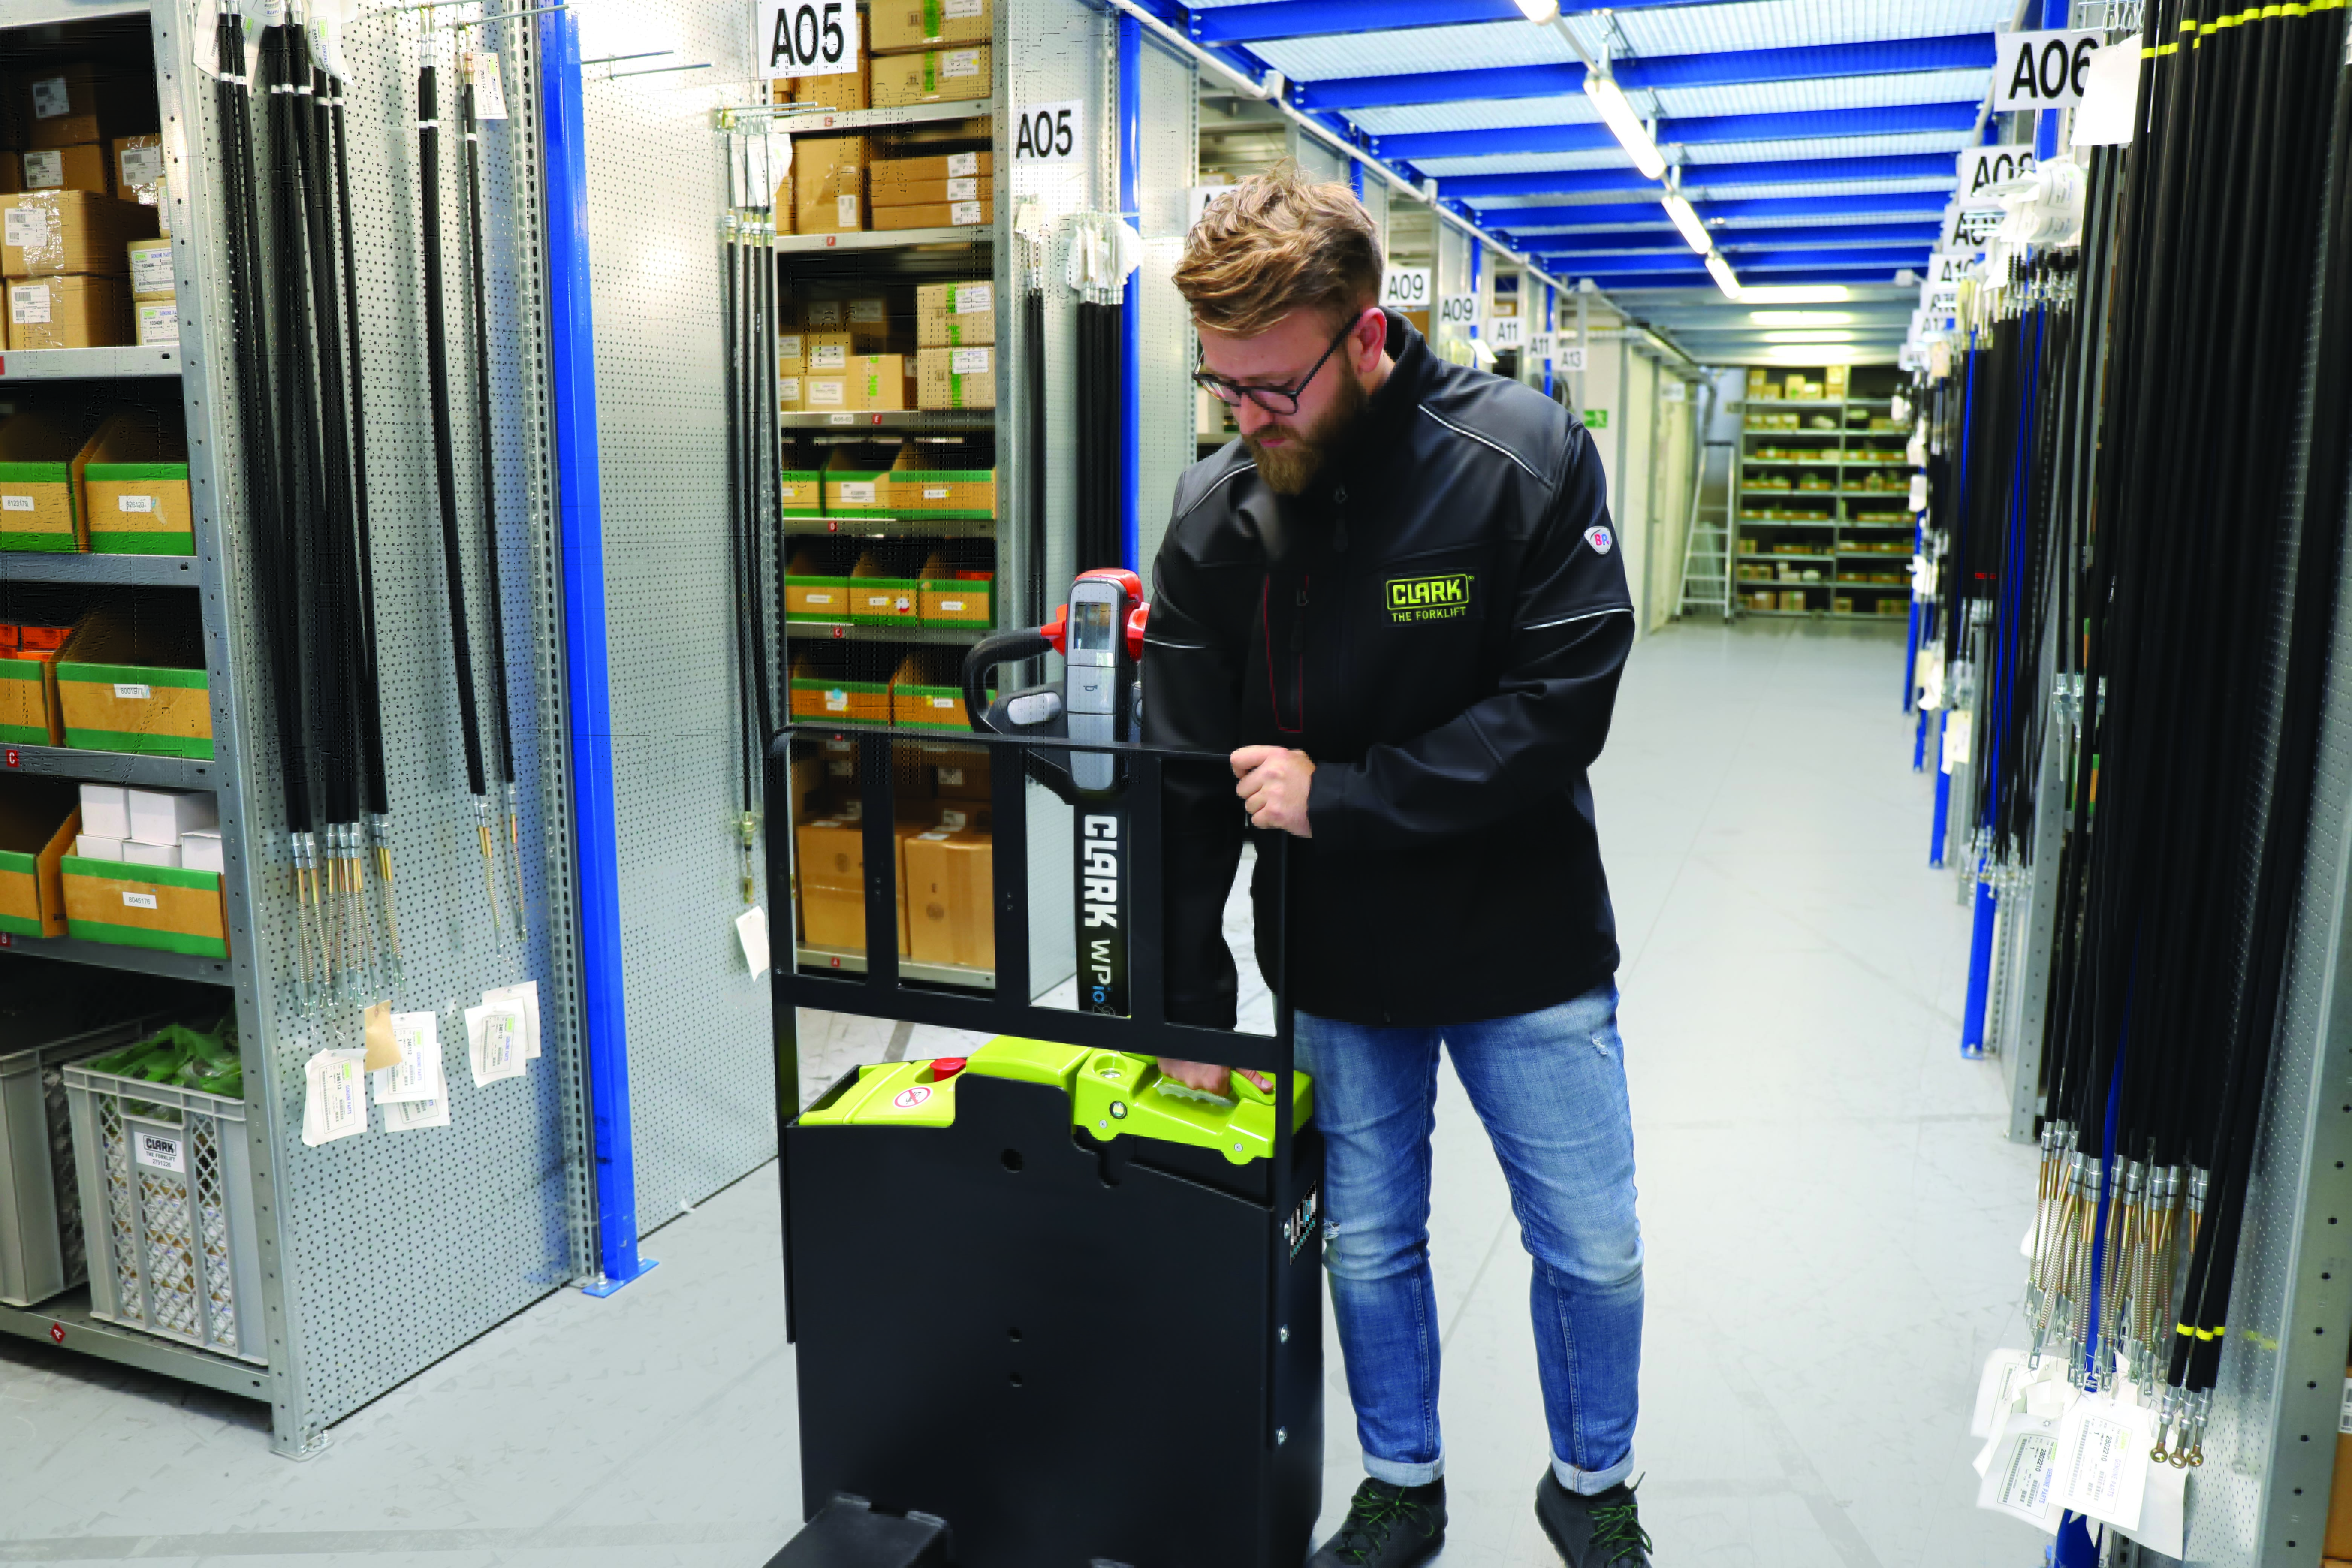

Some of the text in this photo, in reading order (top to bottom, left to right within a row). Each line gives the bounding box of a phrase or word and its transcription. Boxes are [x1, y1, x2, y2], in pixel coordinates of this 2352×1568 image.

[770, 3, 844, 67] A05
[2009, 38, 2099, 99] A06
[1016, 110, 1073, 159] A05
[1387, 274, 1424, 300] A09
[1441, 298, 1473, 322] A09
[1497, 321, 1519, 341] A11
[1530, 338, 1549, 355] A11
[1561, 351, 1581, 368] A13
[1393, 579, 1462, 605] CLARK
[1391, 606, 1466, 622] THE FORKLIFT
[9, 752, 15, 764] C
[1084, 814, 1118, 929] CLARK
[2, 933, 6, 944] B
[146, 1138, 174, 1153] CLARK
[155, 1153, 175, 1162] FORKLIFT
[54, 1329, 62, 1339] A
[2101, 1435, 2112, 1462] 2802210
[2035, 1448, 2047, 1472] 2802210
[2111, 1458, 2121, 1479] GENUINE
[2039, 1468, 2053, 1504] GENUINE PARTS
[2107, 1481, 2116, 1497] PARTS
